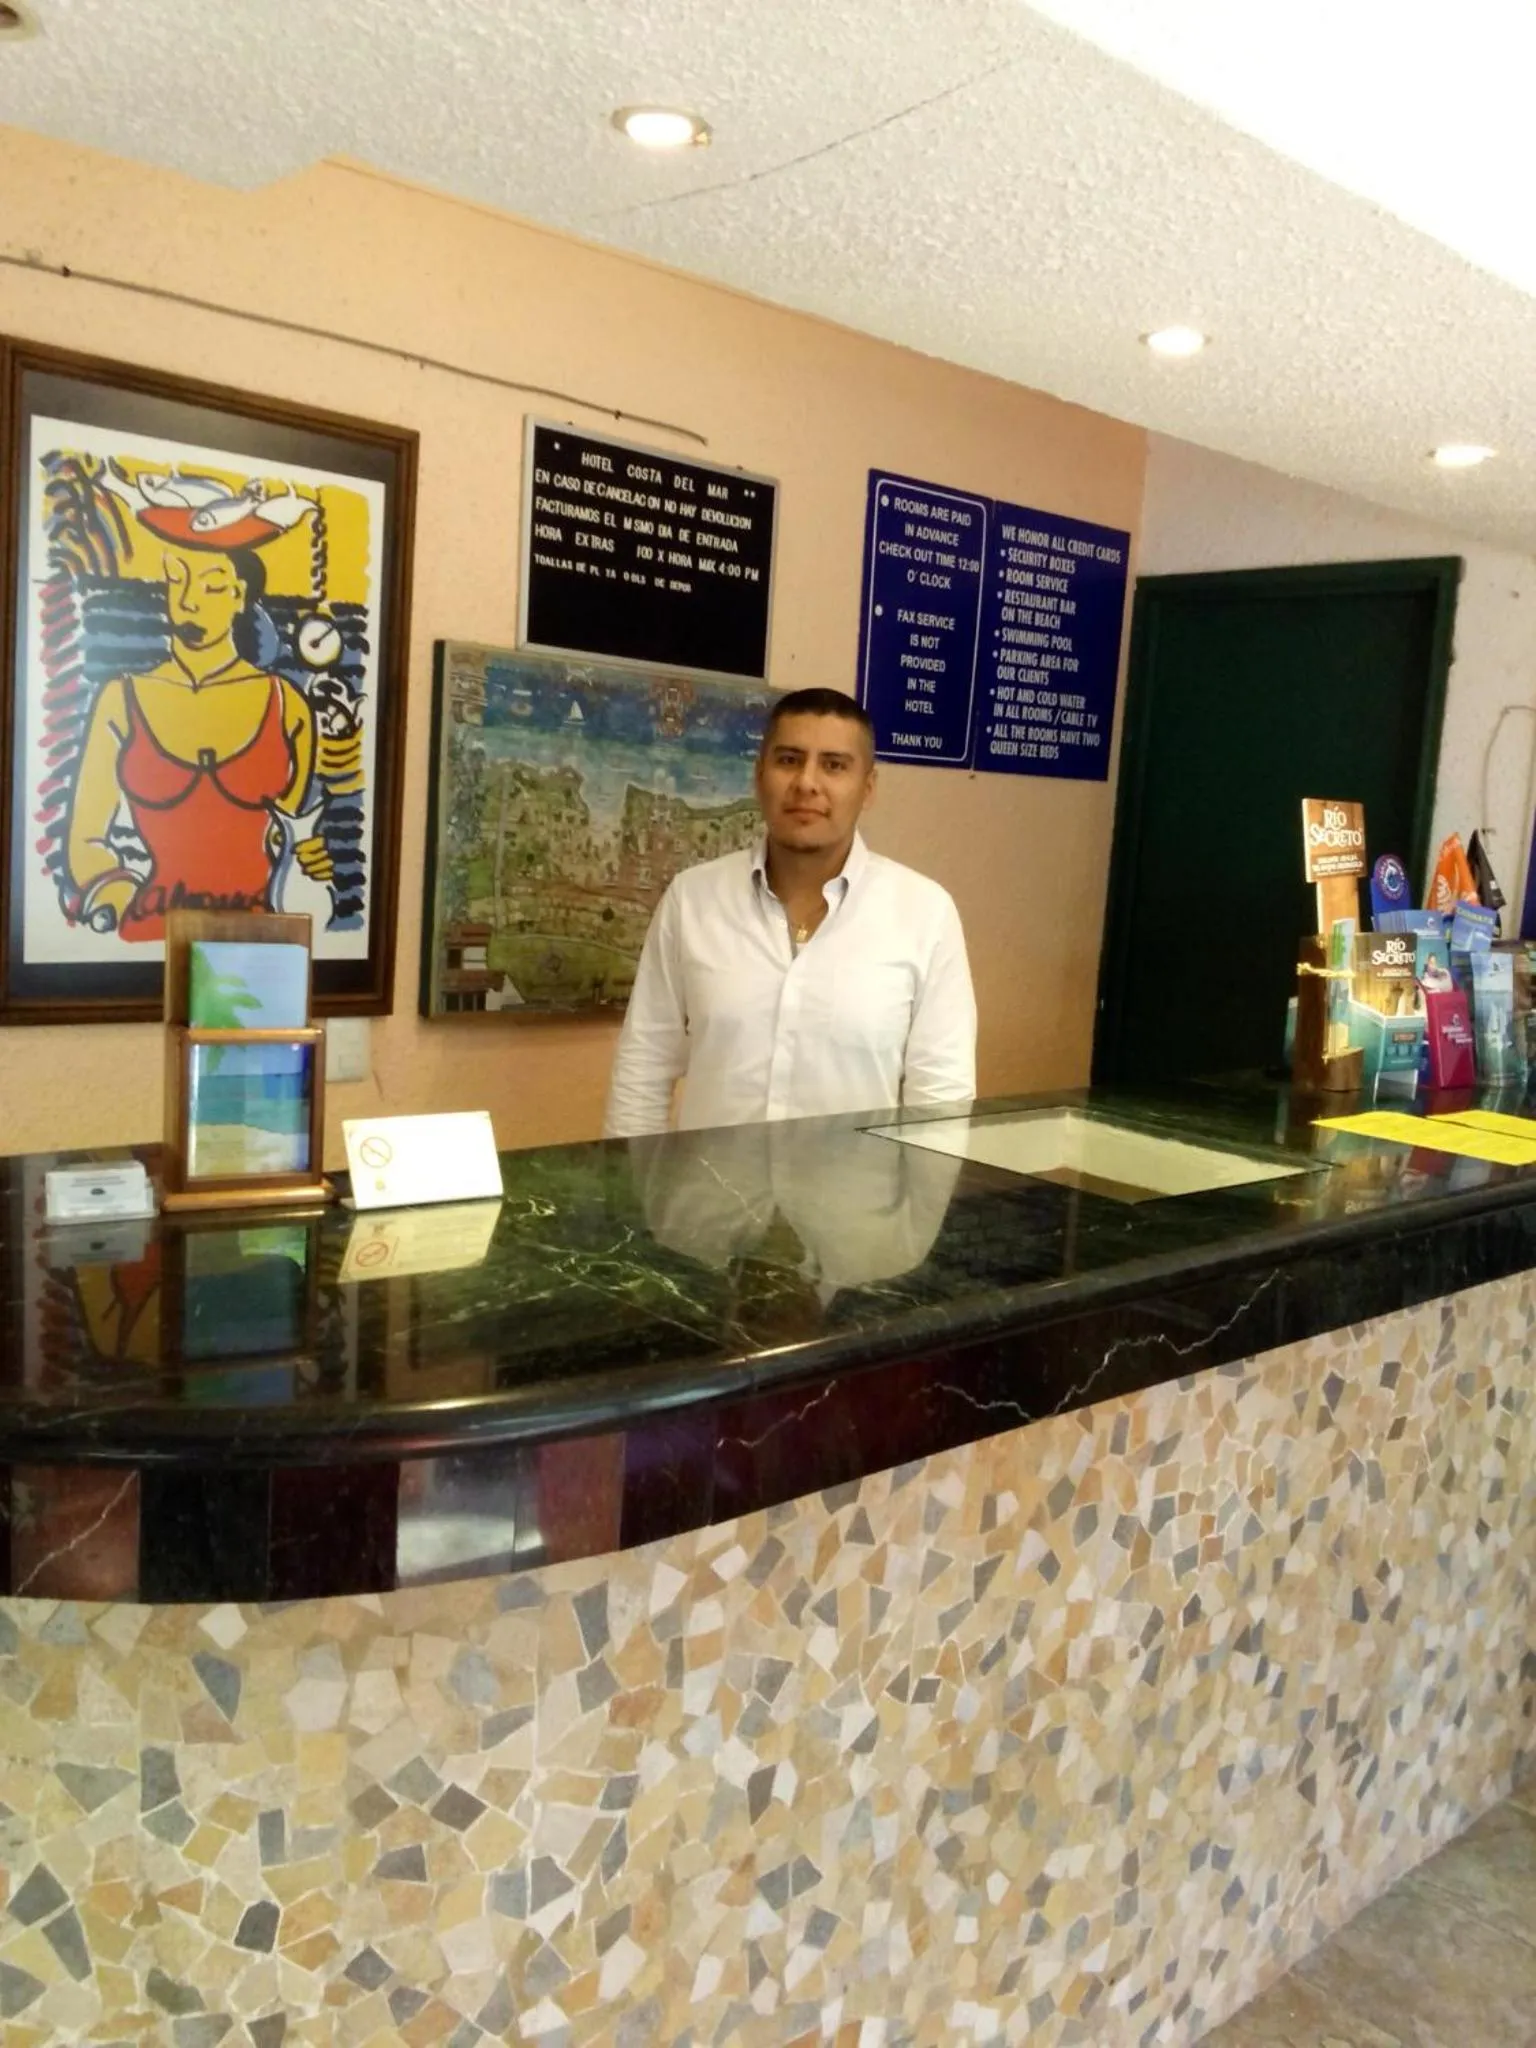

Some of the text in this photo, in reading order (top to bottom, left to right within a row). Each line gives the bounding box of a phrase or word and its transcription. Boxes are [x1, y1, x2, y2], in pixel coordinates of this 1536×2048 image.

[581, 452, 728, 500] HOTEL COSTA DEL MAR
[535, 469, 752, 530] EN CASO DE CANCELACON NO HAY DEVOLUCION
[894, 496, 972, 527] ROOMS ARE PAID
[535, 496, 738, 553] FACTURAMOS EL MSMO DIA DE ENTRADA
[904, 523, 959, 547] IN ADVANCE
[535, 524, 759, 581] HORA EXTRAS 100 X HORA MAX 4:00 PM
[1002, 524, 1121, 563] WE HONOR ALL CREDIT CARDS
[878, 540, 980, 572] CHECK OUT TIME 12:00
[1007, 547, 1076, 574] SECURITY BOXES
[919, 573, 951, 589] CLOCK
[1005, 568, 1068, 593] ROOM SERVICE
[1005, 589, 1076, 615] RESTAURANT BAR
[897, 608, 955, 631] FAX SERVICE
[1001, 606, 1061, 629] ON THE BEACH
[910, 634, 940, 649] IS NOT
[1002, 627, 1072, 652] SWIMMING POOL
[900, 654, 946, 673] PROVIDED
[999, 648, 1079, 673] PARKING AREA FOR
[907, 677, 936, 693] IN THE
[997, 665, 1050, 685] OUR CLIENTS
[904, 699, 934, 714] HOTEL
[997, 688, 1086, 710] HOT AND COLD WATER
[994, 703, 1005, 716] IN
[1005, 705, 1020, 719] ALL
[1021, 707, 1053, 722] ROOMS
[1086, 713, 1098, 728] TV
[891, 732, 942, 750] THANK YOU
[993, 724, 1101, 747] ALL THE ROOMS HAVE TWO
[990, 741, 1059, 759] QUEEN SIZE BEDS
